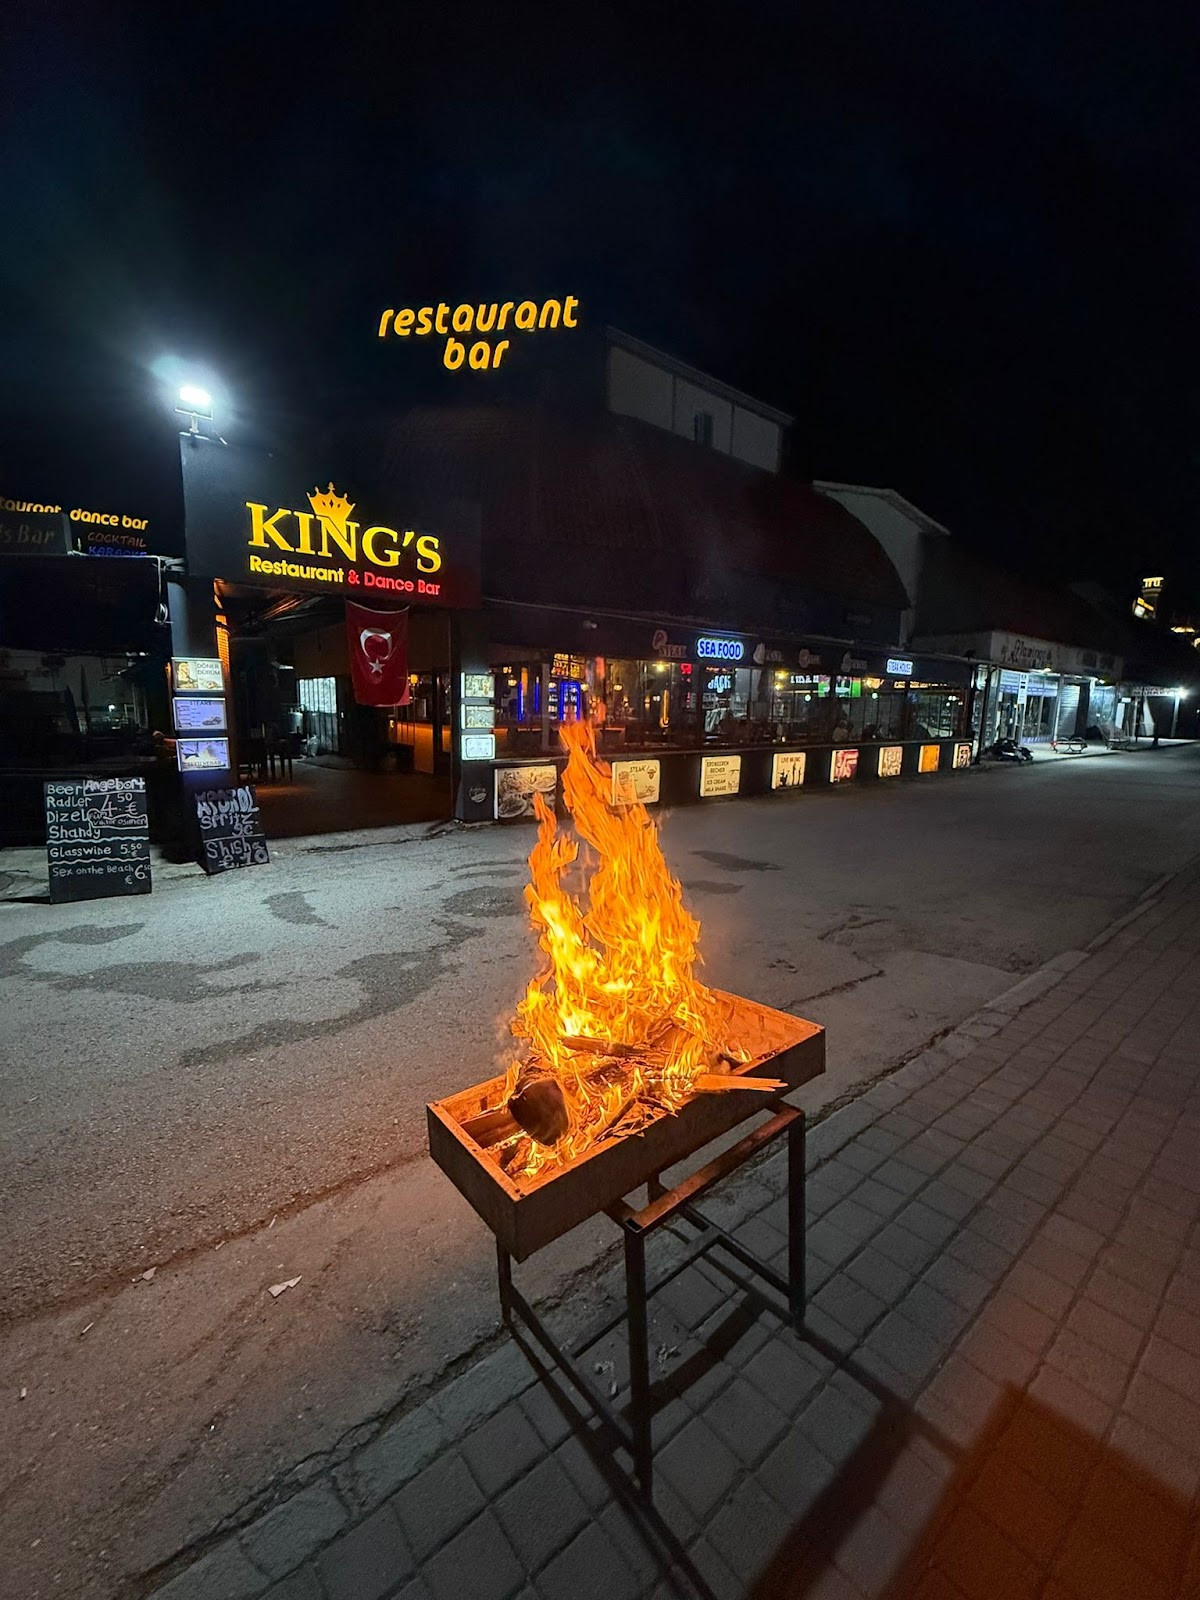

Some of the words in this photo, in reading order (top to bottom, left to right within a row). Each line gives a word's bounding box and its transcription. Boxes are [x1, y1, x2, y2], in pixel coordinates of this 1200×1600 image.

[378, 296, 578, 337] restaurant
[443, 338, 510, 370] bar
[70, 508, 119, 526] dance
[121, 514, 149, 531] bar
[17, 524, 55, 544] Bar
[87, 531, 147, 548] COCKTAIL
[246, 502, 442, 573] KING'S
[249, 555, 344, 583] Restaurant
[347, 569, 360, 585] &
[364, 571, 414, 592] Dance
[417, 580, 441, 596] Bar
[699, 641, 716, 656] SEA
[718, 643, 741, 658] FOOD
[629, 764, 646, 773] STEAK
[47, 784, 83, 796] Beer
[46, 796, 92, 808] Radler
[46, 808, 90, 824] Dizel
[49, 823, 101, 839] Shandy
[49, 845, 112, 857] Glasswine
[205, 837, 265, 859] Shisha
[52, 867, 73, 877] Sex
[107, 864, 134, 873] Beach
